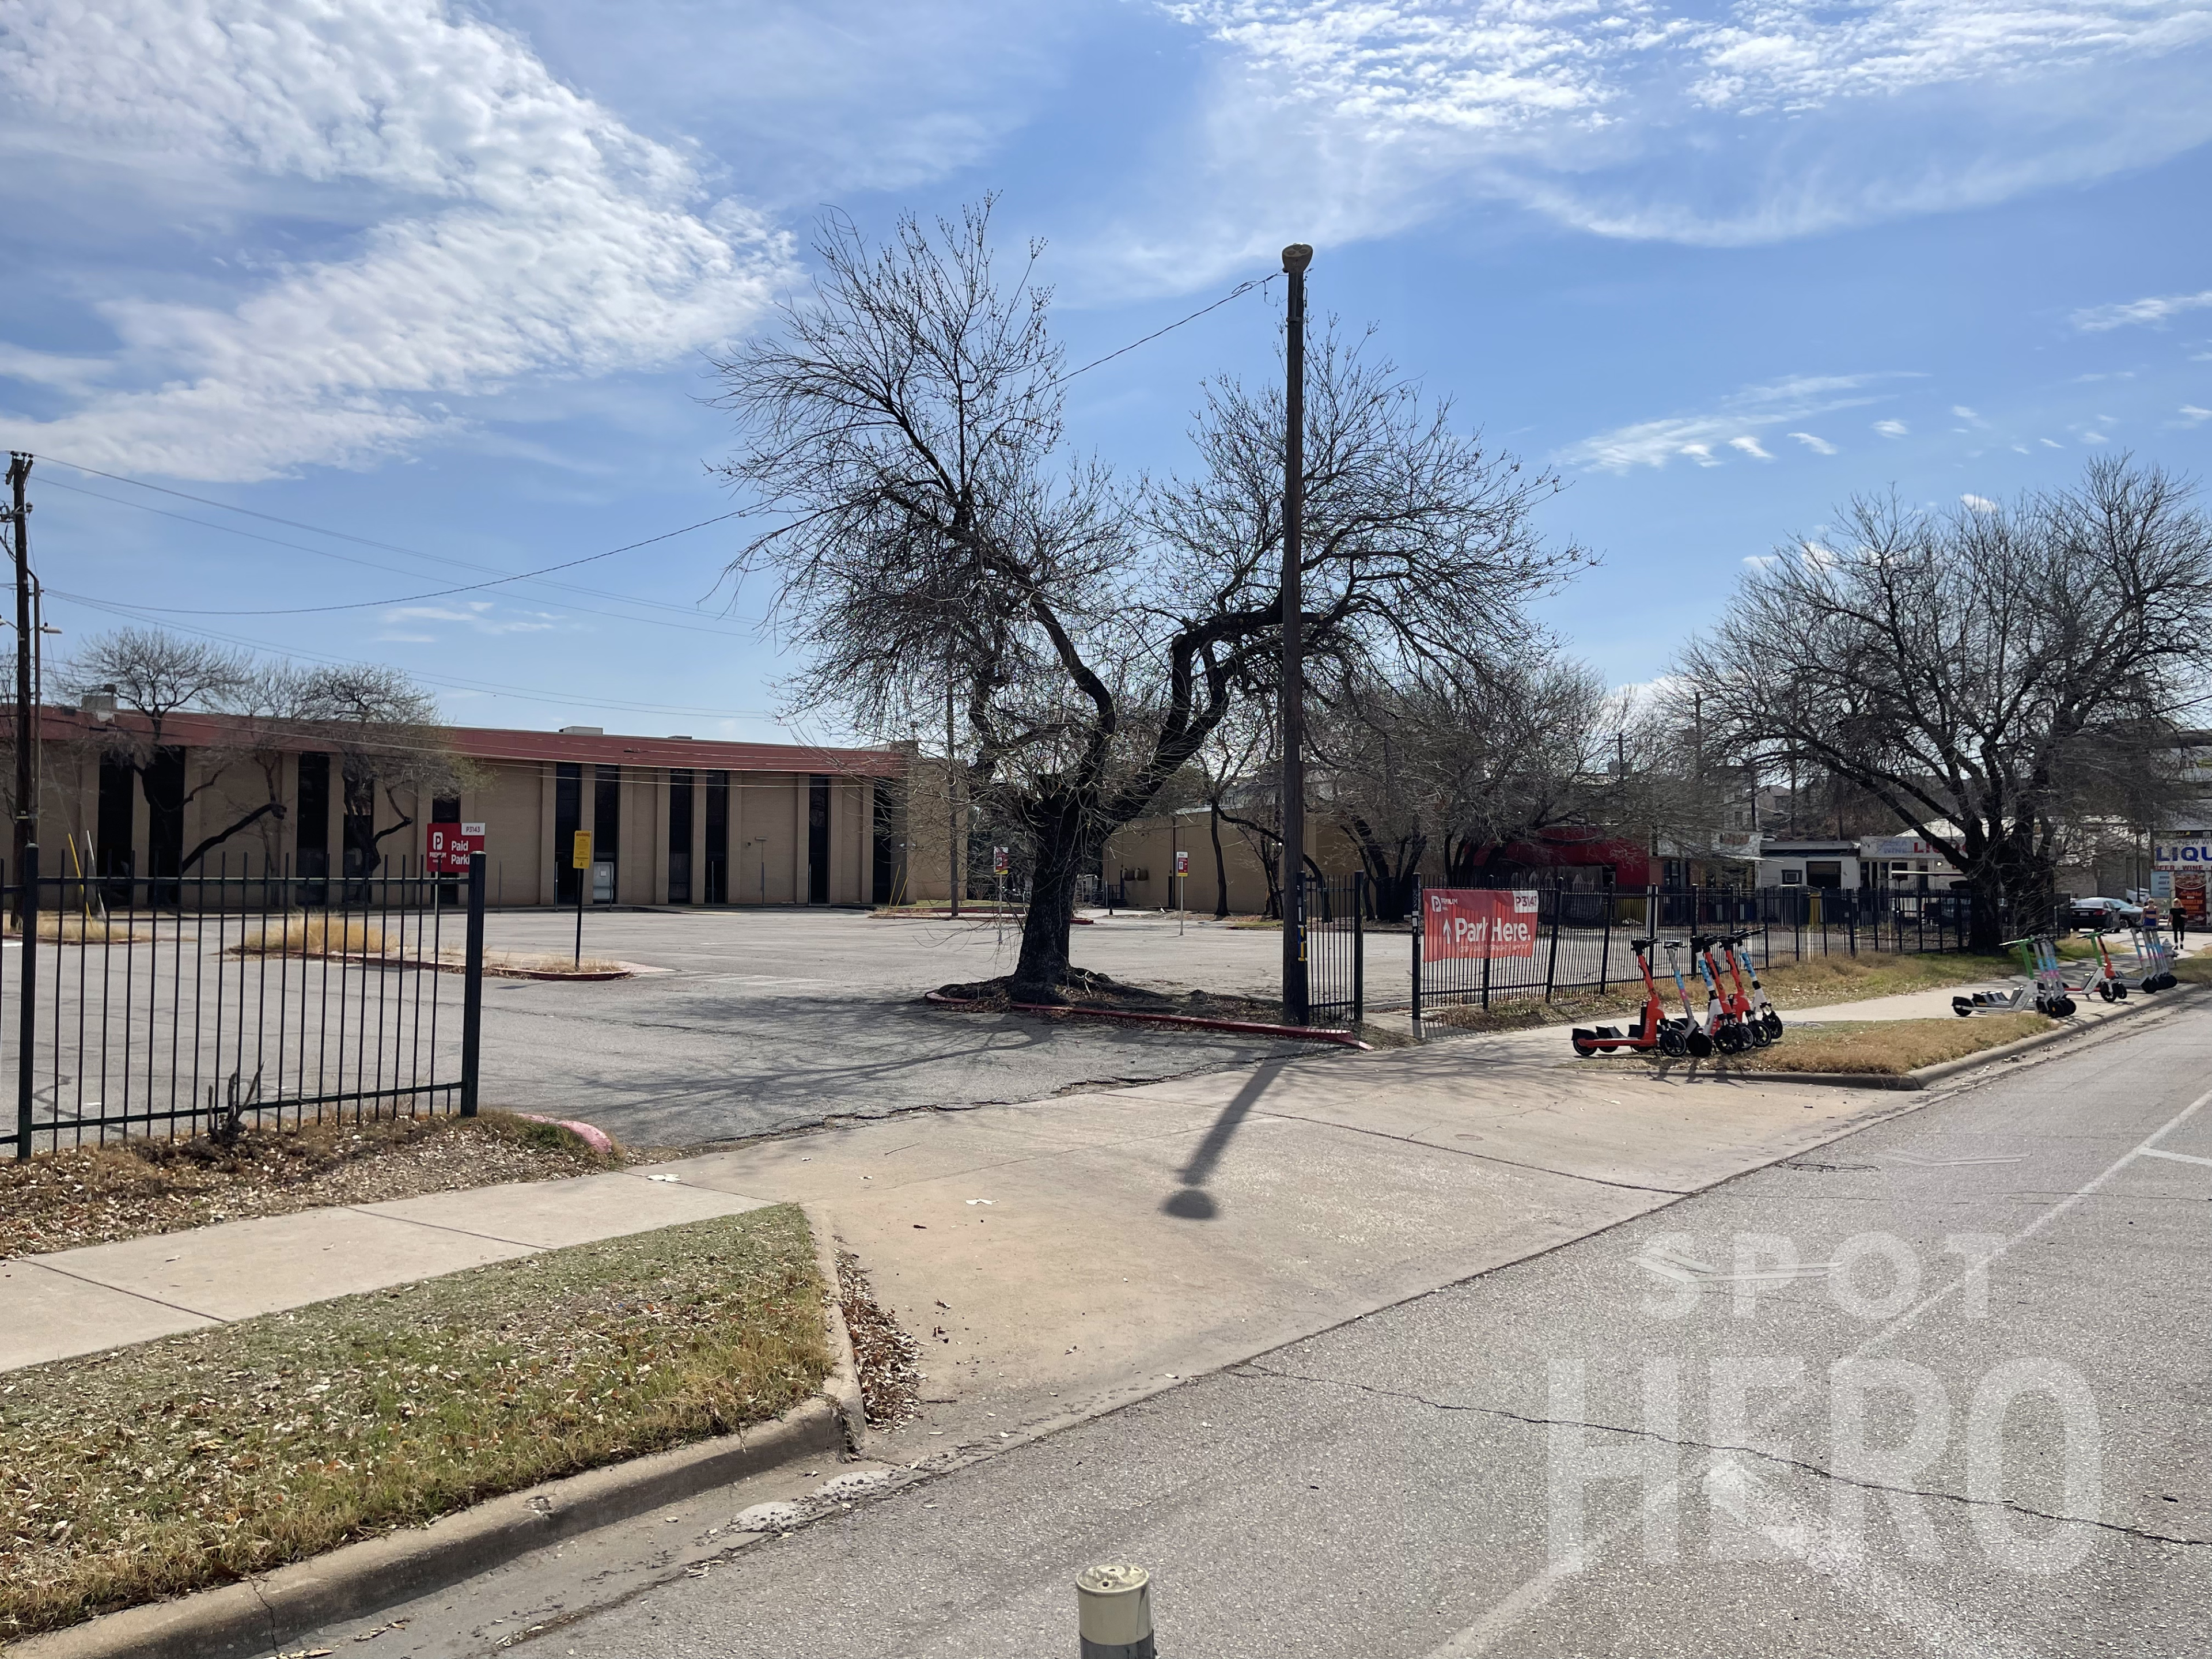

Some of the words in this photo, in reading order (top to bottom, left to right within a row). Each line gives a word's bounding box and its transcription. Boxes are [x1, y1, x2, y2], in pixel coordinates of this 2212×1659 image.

[451, 840, 469, 851] Paid
[450, 854, 470, 865] Parki
[1491, 918, 1531, 942] Here.
